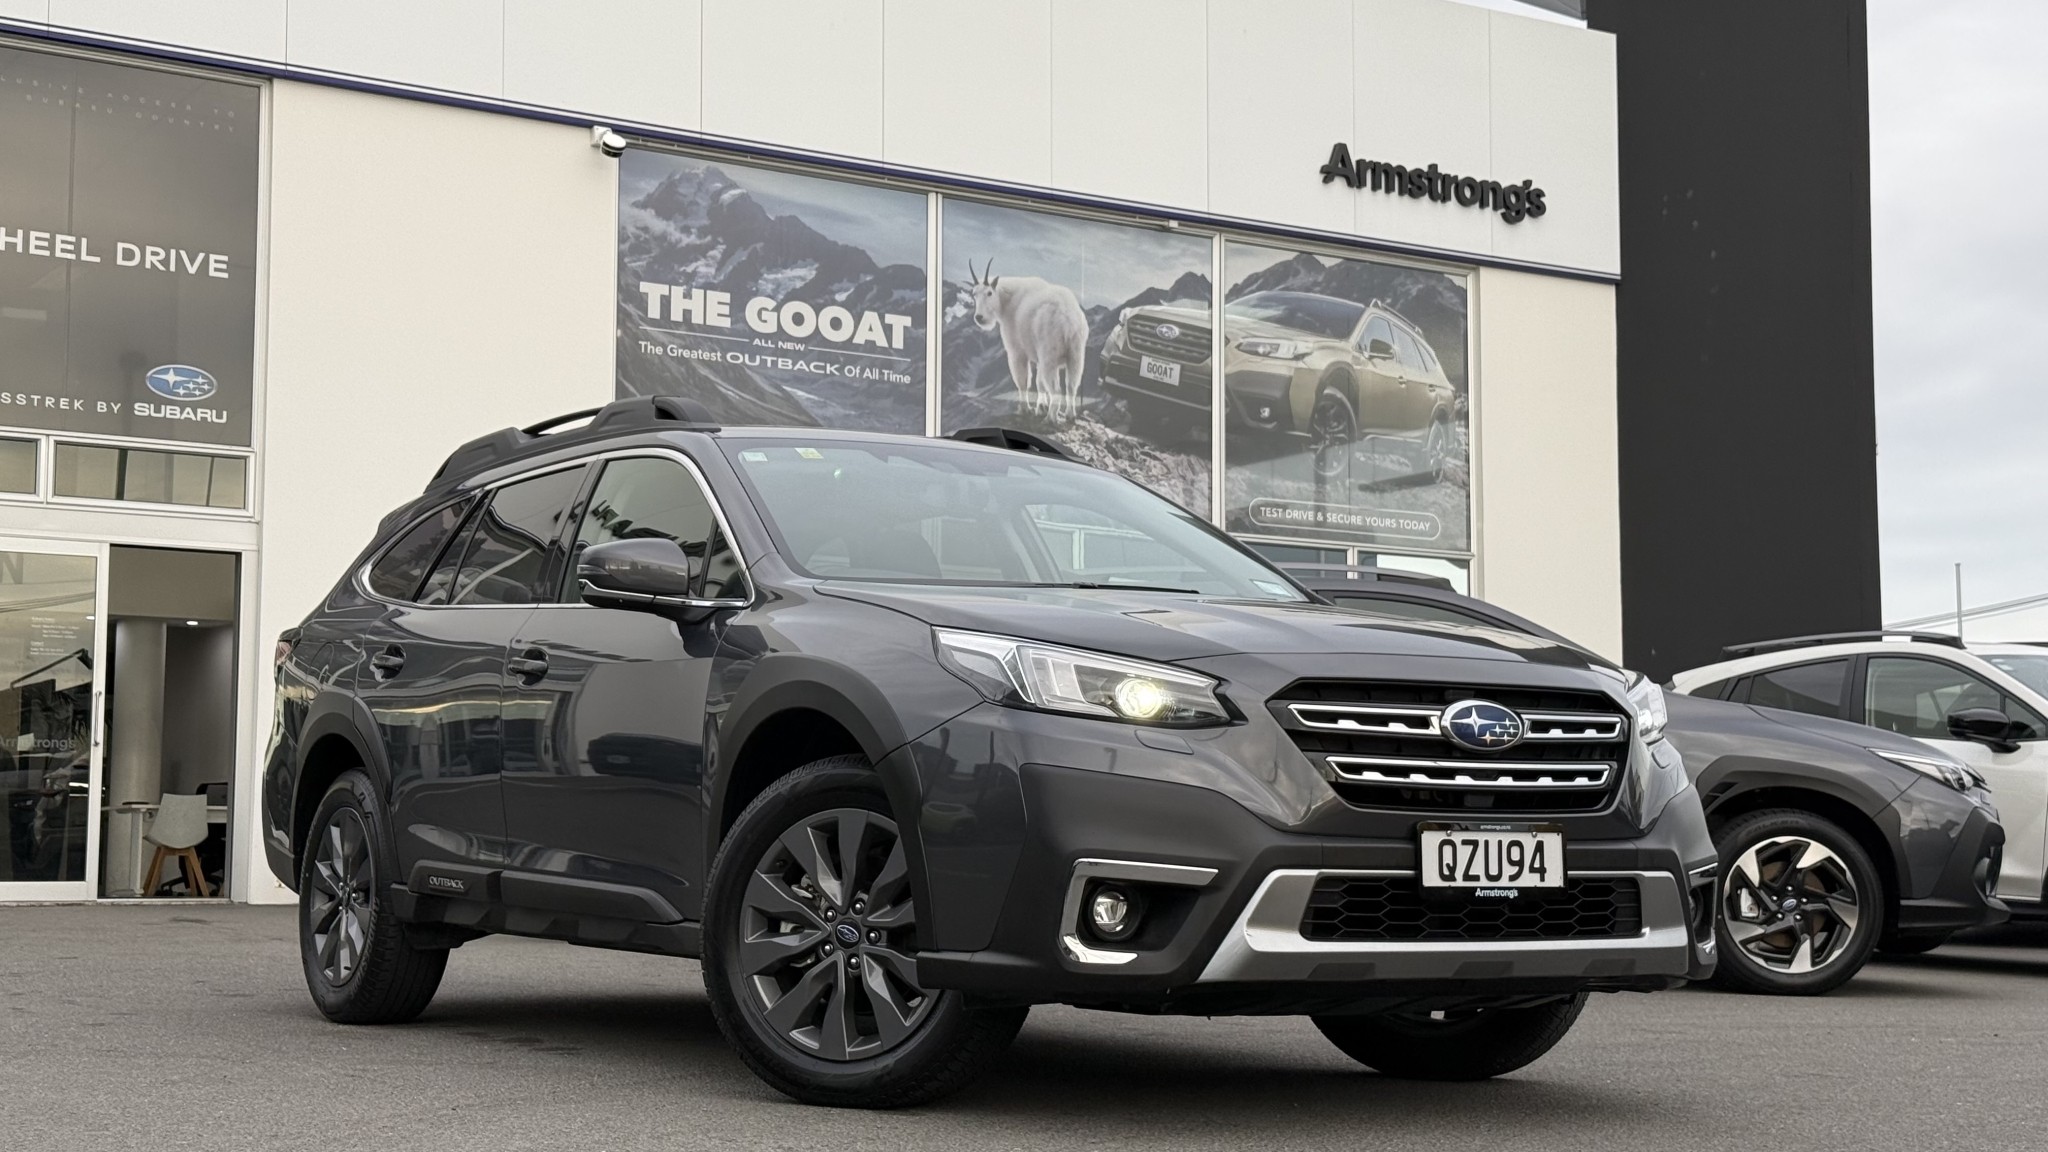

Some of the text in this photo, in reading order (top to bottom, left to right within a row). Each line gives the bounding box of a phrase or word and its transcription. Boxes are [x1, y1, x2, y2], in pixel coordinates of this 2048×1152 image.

[213, 108, 235, 119] TO
[1319, 142, 1547, 225] Armstrong's
[0, 226, 229, 279] HEEL DRIVE
[639, 281, 912, 349] THE GOOAT
[752, 338, 805, 351] ALL NEW
[639, 341, 911, 384] The Greatest OUTBACK Of All Time
[1146, 361, 1174, 380] GOOAT
[0, 392, 228, 424] SSTREK BY SUBARU
[1260, 507, 1431, 532] TEST DRIVE & SECURE YOURS TODAY
[1438, 838, 1547, 882] QZU94
[429, 876, 464, 889] OUTBACK
[1475, 887, 1518, 899] Armstrong's
